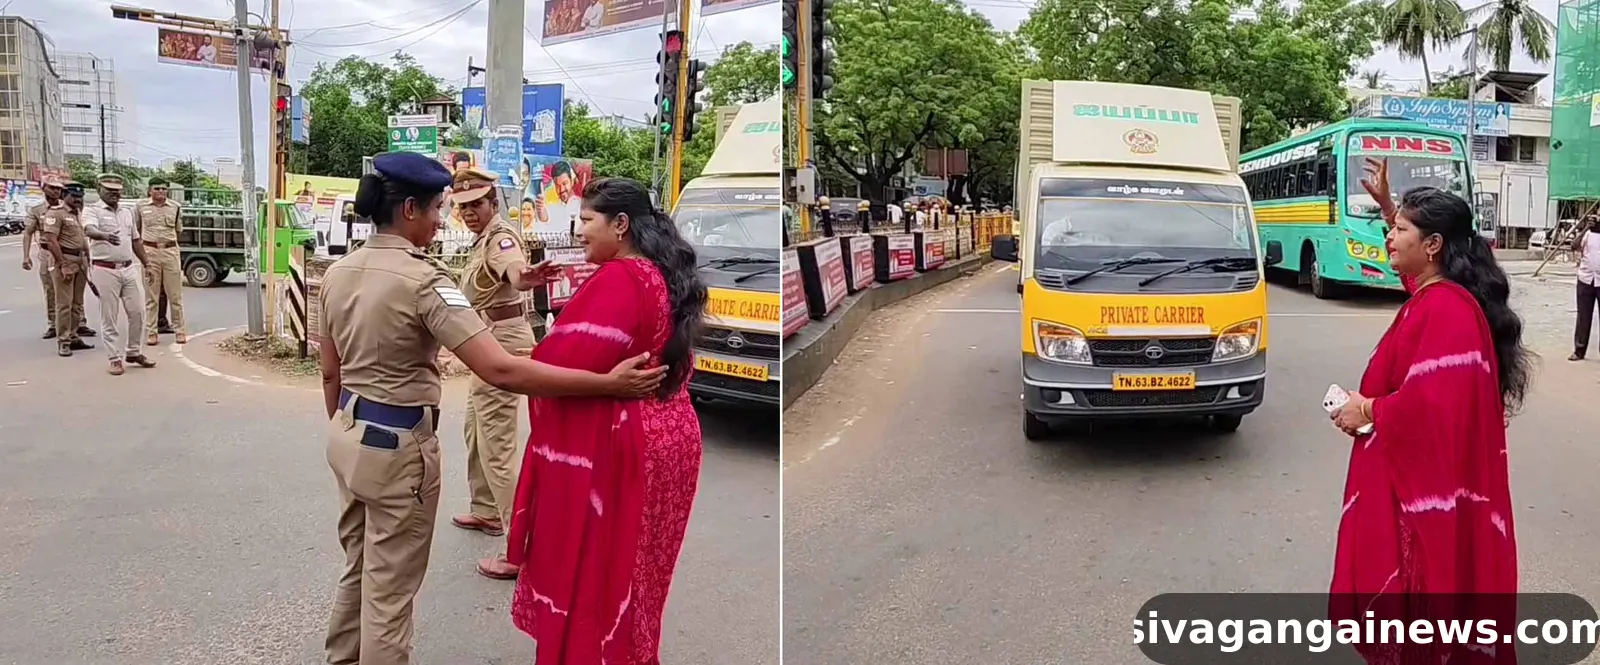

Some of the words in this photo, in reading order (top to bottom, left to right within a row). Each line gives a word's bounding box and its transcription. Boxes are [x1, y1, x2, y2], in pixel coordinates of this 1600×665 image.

[1361, 134, 1453, 155] NNS
[1100, 306, 1149, 323] PRIVATE
[1154, 306, 1205, 323] CARRIER
[700, 359, 764, 378] TN.63.BZ.4622
[1118, 376, 1190, 387] TN.63.BZ.4622
